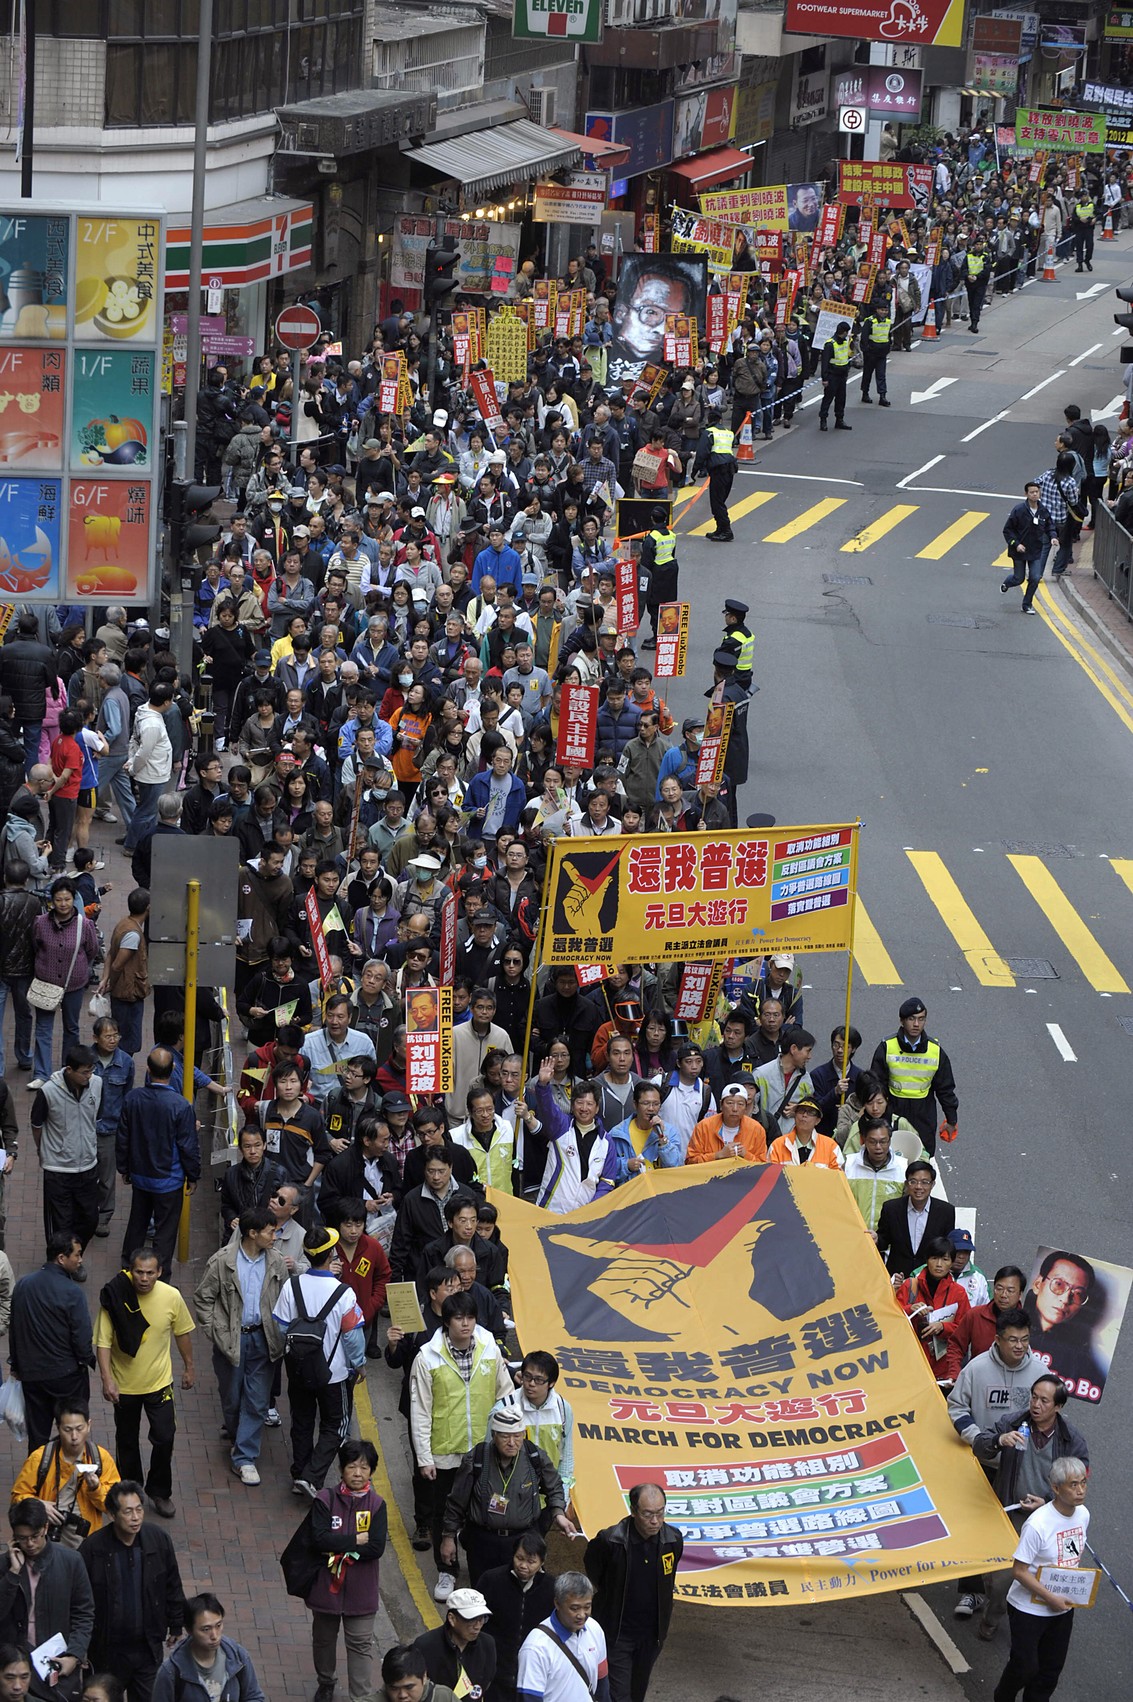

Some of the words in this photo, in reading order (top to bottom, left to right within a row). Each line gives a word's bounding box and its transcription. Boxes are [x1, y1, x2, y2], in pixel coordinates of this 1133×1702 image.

[797, 4, 837, 14] FOOTWEAR
[839, 8, 888, 18] SUPERMARKET
[1020, 127, 1100, 144] 支持零八憲章
[842, 164, 903, 179] 結束一黨專政
[706, 190, 784, 211] 抗議重判劉曉波
[84, 222, 117, 244] 2/F
[46, 220, 64, 296] 西式美食
[136, 224, 154, 300] 中式美食
[42, 352, 60, 392] 肉類
[82, 356, 112, 376] 1/F
[132, 356, 150, 395] 蔬果
[476, 374, 499, 416] 五區公投
[38, 484, 56, 522] 海鮮
[74, 486, 108, 506] G/F
[127, 486, 146, 524] 燒味
[620, 564, 635, 624] 結束一黨專政
[657, 643, 675, 676] 劉曉波
[678, 632, 687, 675] LiuXiaobo
[566, 687, 591, 758] 建設民主中國
[724, 704, 734, 730] FREE
[698, 747, 717, 783] 刘晓波
[715, 733, 728, 780] LiuXiaobo
[786, 833, 840, 855] 取消功能組別
[627, 840, 769, 894] 還我普選
[781, 852, 842, 876] 反對區議會方案
[780, 872, 842, 896] 力爭普選路線圖
[644, 899, 748, 931] 元旦大遊行
[552, 937, 613, 952] 還我普選
[664, 938, 728, 951] 民主派立法會議員
[442, 990, 451, 1023] FREE
[678, 976, 706, 1018] 刘晓波
[704, 962, 723, 1019] LiuXiaobo
[406, 1034, 439, 1043] 抗议重判
[410, 1045, 436, 1092] 刘晓波
[442, 1028, 451, 1090] LiuXiaobo
[554, 1303, 882, 1382] 還我普選
[564, 1376, 793, 1399] DEMOCRACY
[807, 1350, 889, 1389] NOW
[1077, 1380, 1100, 1399] Bo
[608, 1389, 868, 1426] 元旦大遊行
[578, 1422, 678, 1447] MARCH
[686, 1432, 743, 1448] FOR
[748, 1410, 915, 1448] DEMOCRACY
[664, 1452, 860, 1487] 取消功能組別
[666, 1474, 888, 1515] 反對區議會方案
[800, 1574, 856, 1593] 民主動力
[870, 1564, 913, 1582] Power
[916, 1560, 935, 1572] for
